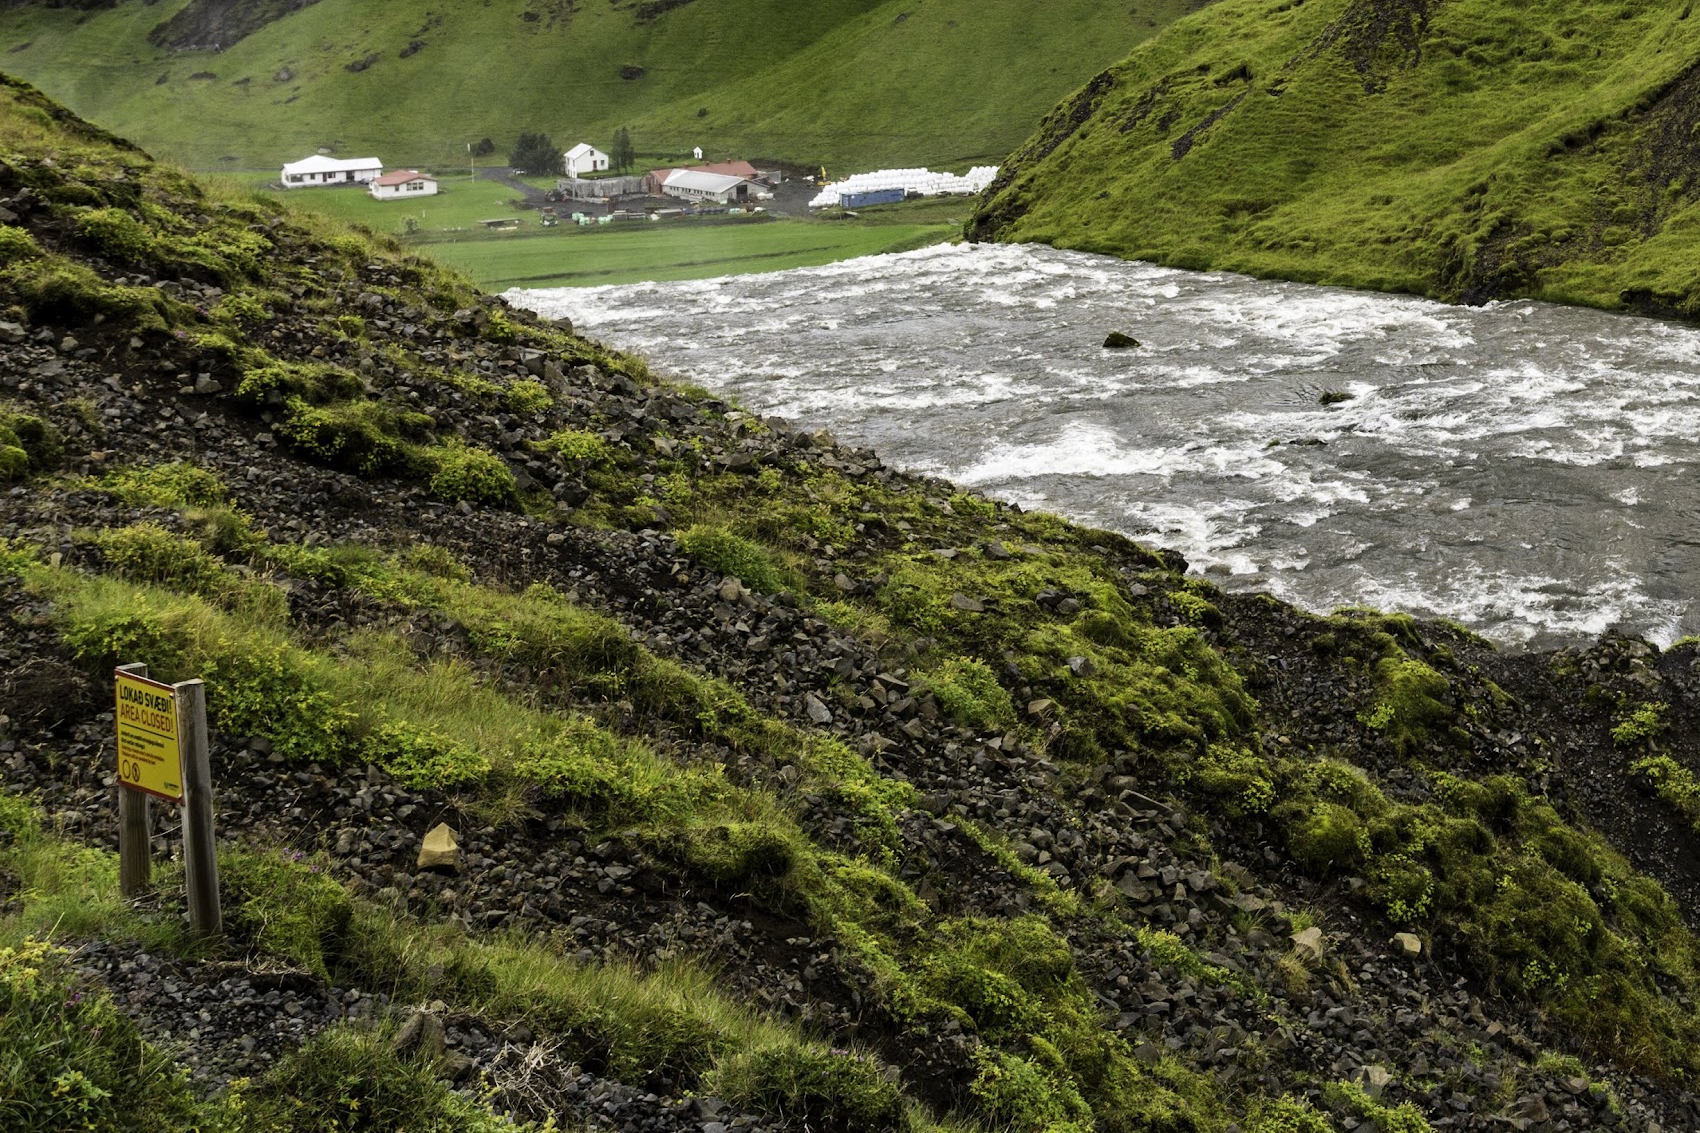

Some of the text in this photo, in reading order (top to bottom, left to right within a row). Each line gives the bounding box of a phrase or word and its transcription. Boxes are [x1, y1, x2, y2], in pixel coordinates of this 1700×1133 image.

[120, 685, 143, 705] LOKAÐ
[120, 703, 173, 734] AREA CLOSED!
